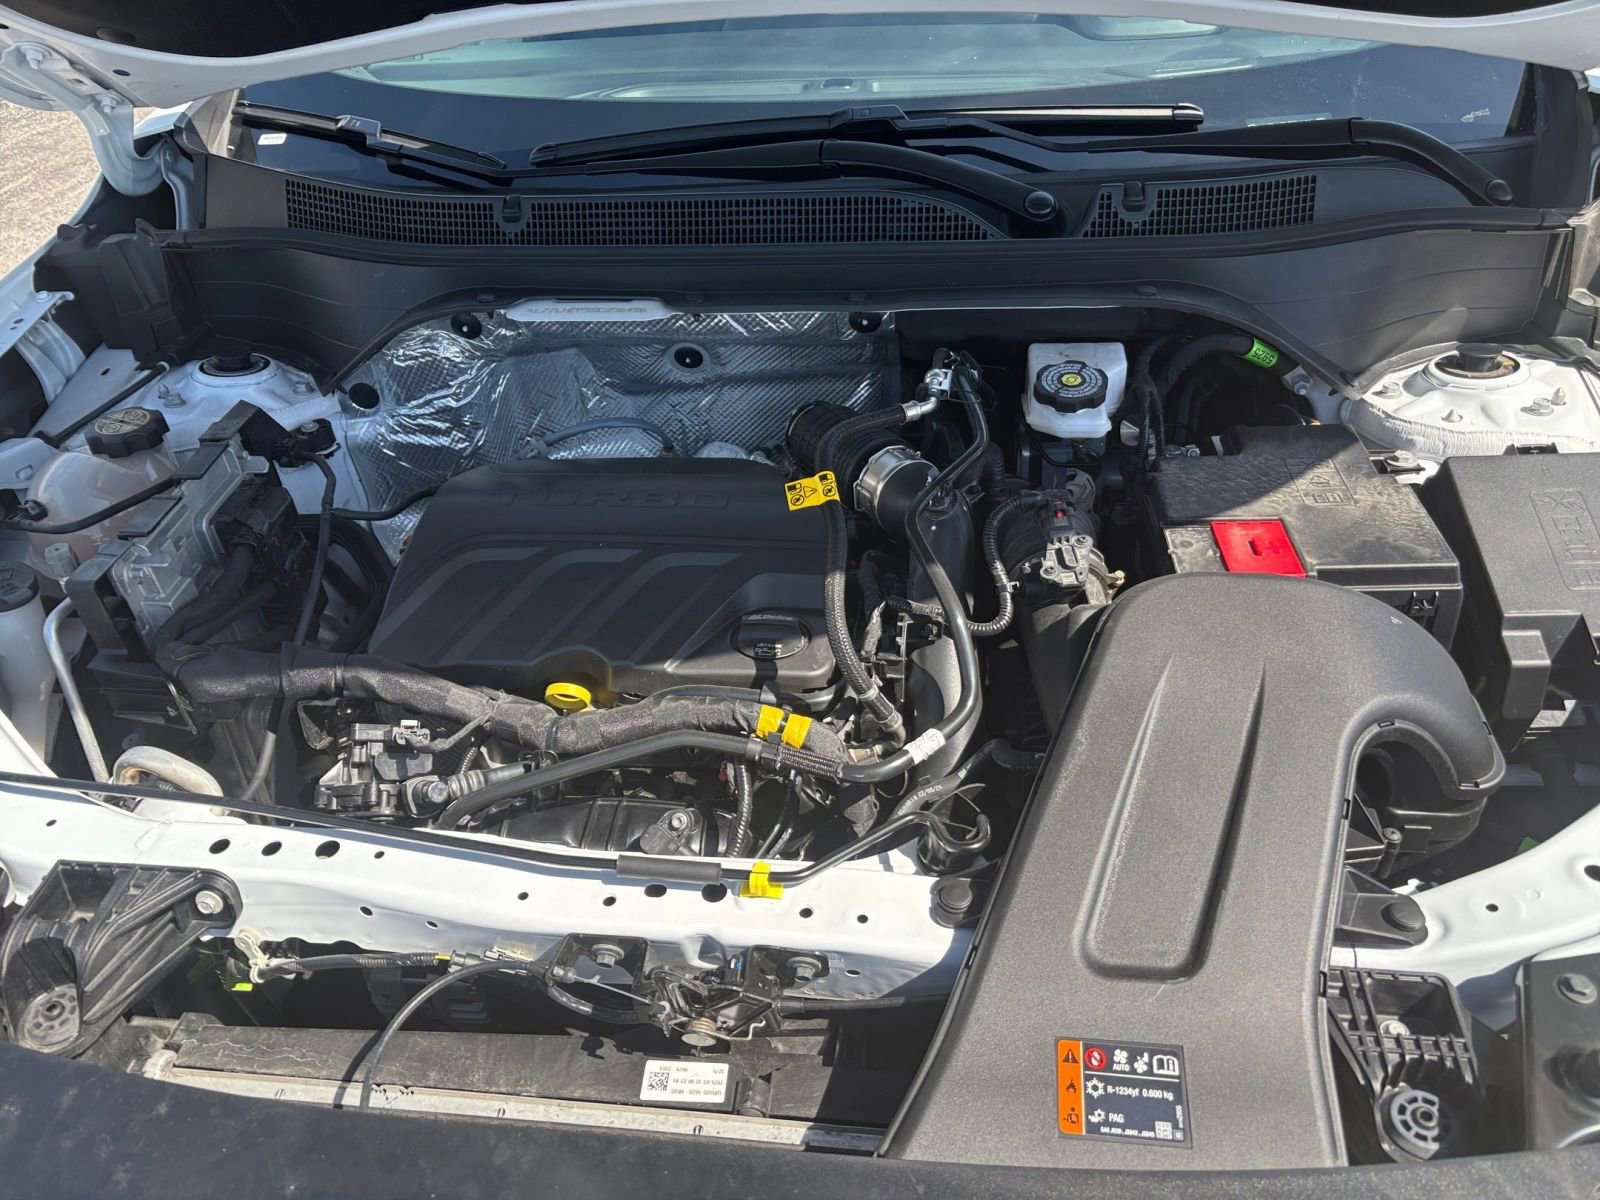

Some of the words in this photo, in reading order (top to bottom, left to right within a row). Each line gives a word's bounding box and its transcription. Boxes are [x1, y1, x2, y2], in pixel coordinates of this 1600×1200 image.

[1251, 347, 1275, 365] 5925
[487, 490, 733, 510] TURBO
[1112, 1063, 1130, 1072] AUTO
[1106, 1085, 1139, 1098] R-1234yf
[1163, 1091, 1174, 1101] kg
[1108, 1112, 1125, 1123] PAG
